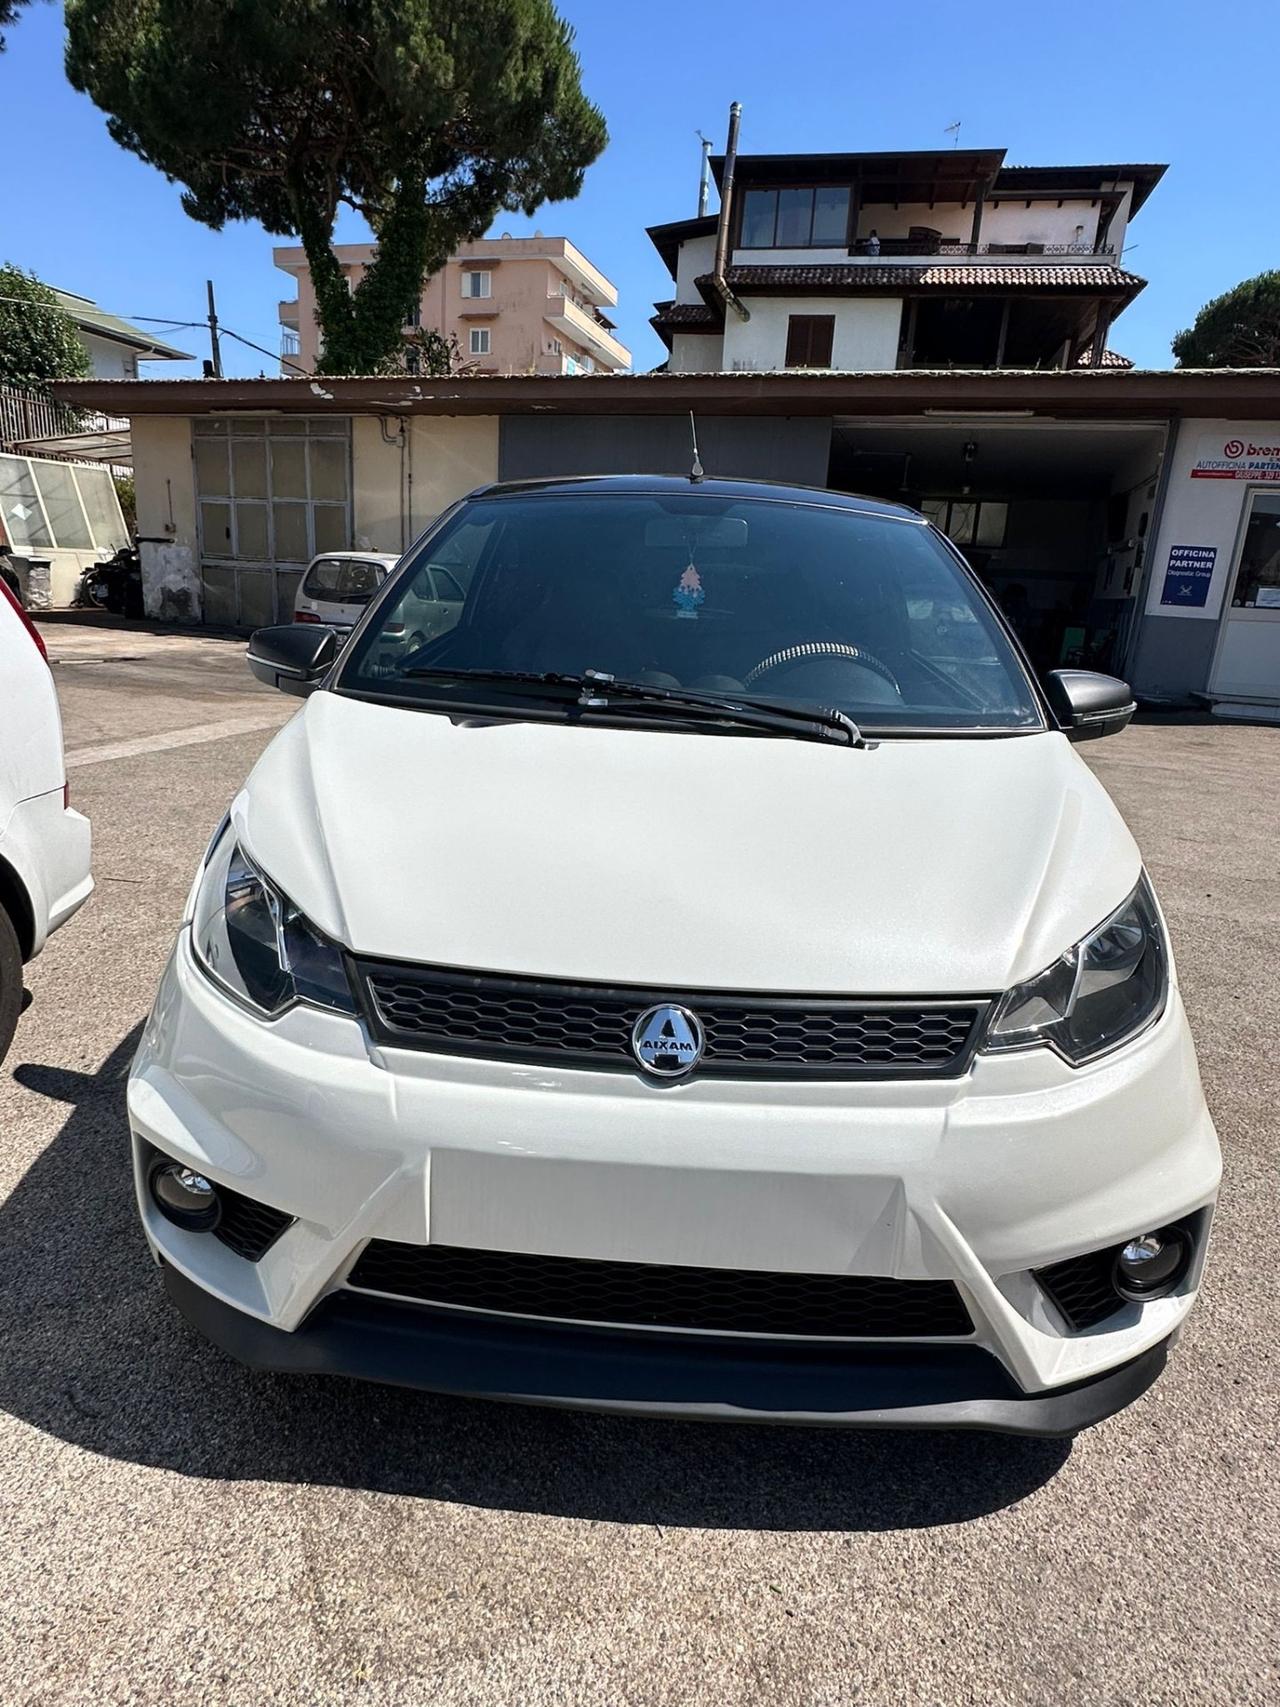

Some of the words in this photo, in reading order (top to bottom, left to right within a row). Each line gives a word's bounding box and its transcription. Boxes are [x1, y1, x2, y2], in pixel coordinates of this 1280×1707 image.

[1171, 549, 1215, 558] OFFICINA
[1169, 559, 1213, 569] PARTNER
[643, 1040, 693, 1051] AIXAM
